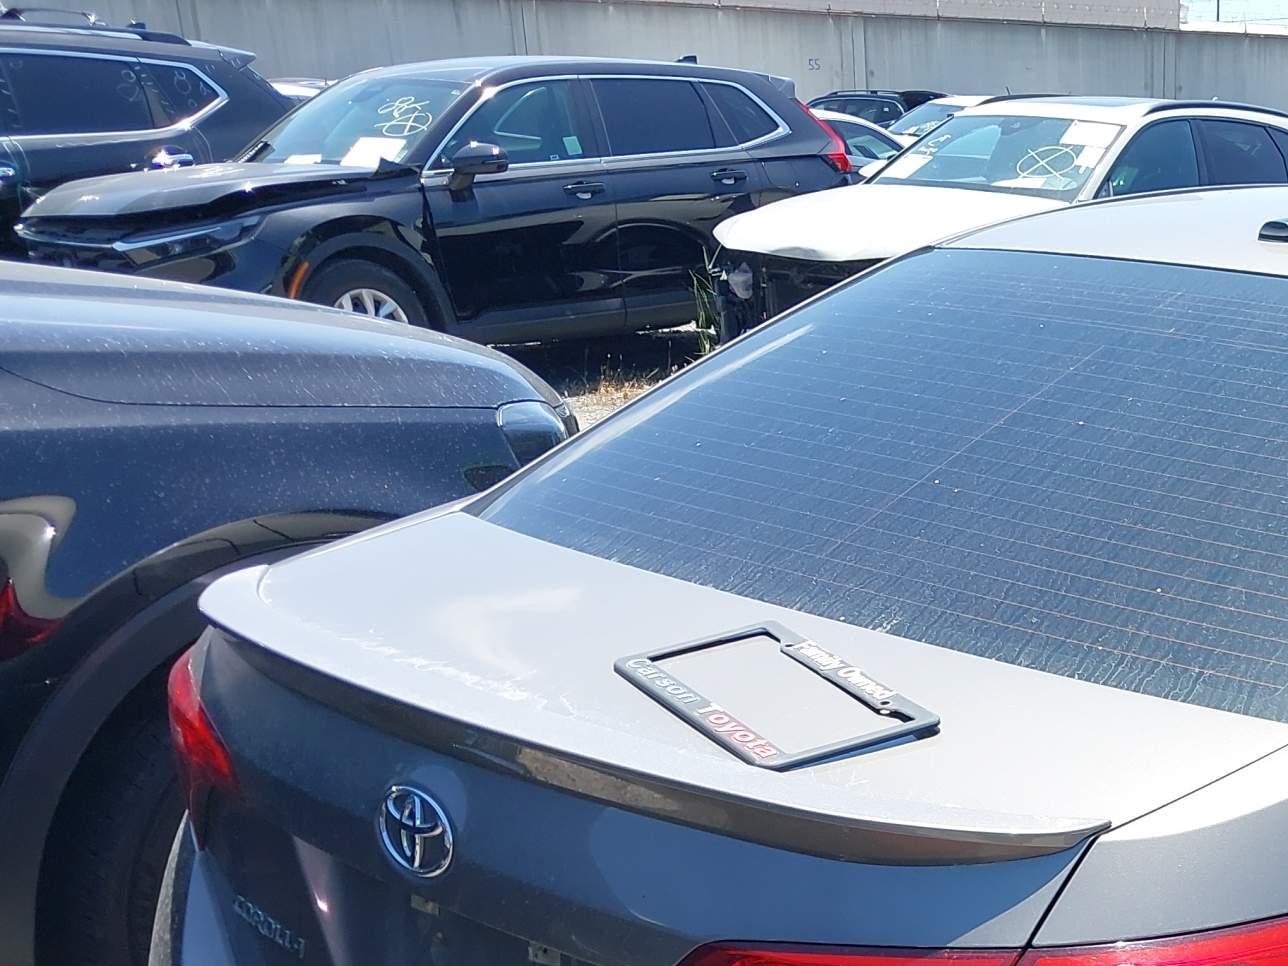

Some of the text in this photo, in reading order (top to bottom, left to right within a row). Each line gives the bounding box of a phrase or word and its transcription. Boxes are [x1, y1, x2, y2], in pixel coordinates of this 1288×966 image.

[808, 58, 821, 71] 55
[793, 640, 897, 700] Family Owned
[625, 658, 778, 759] Carson Toyota
